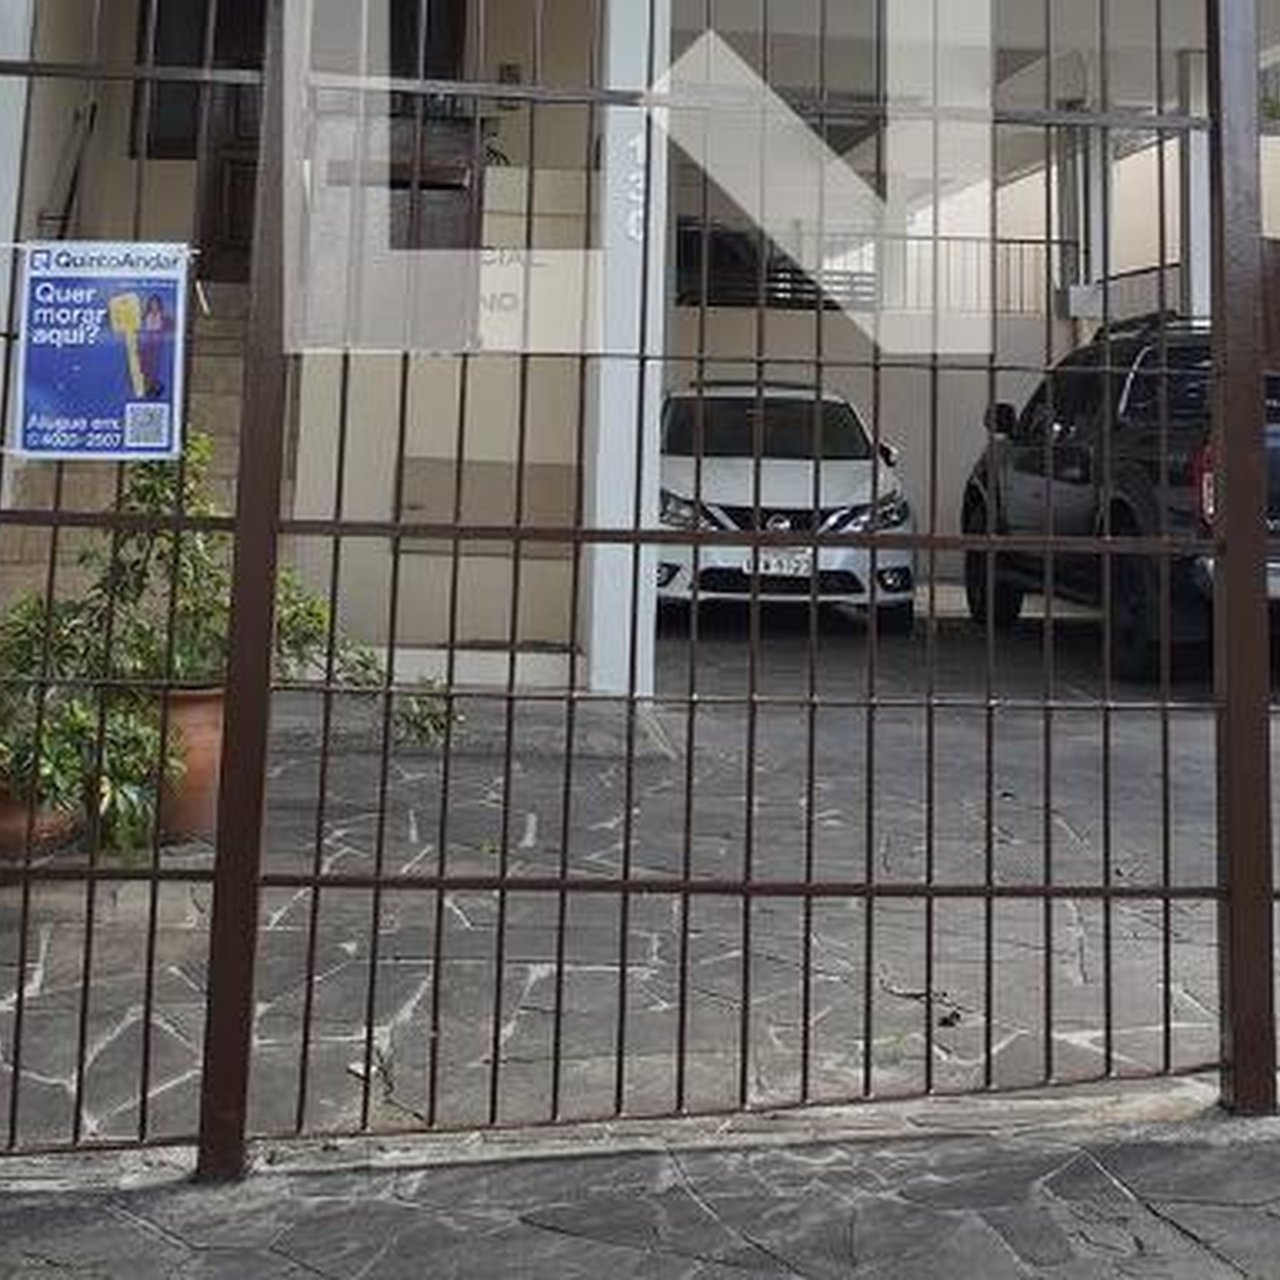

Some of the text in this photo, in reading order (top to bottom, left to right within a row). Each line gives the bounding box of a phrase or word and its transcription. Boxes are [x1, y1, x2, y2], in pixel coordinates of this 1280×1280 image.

[55, 252, 180, 270] QuintoAndar
[35, 282, 97, 304] Quer
[32, 307, 106, 324] morar
[31, 323, 101, 348] aqui?
